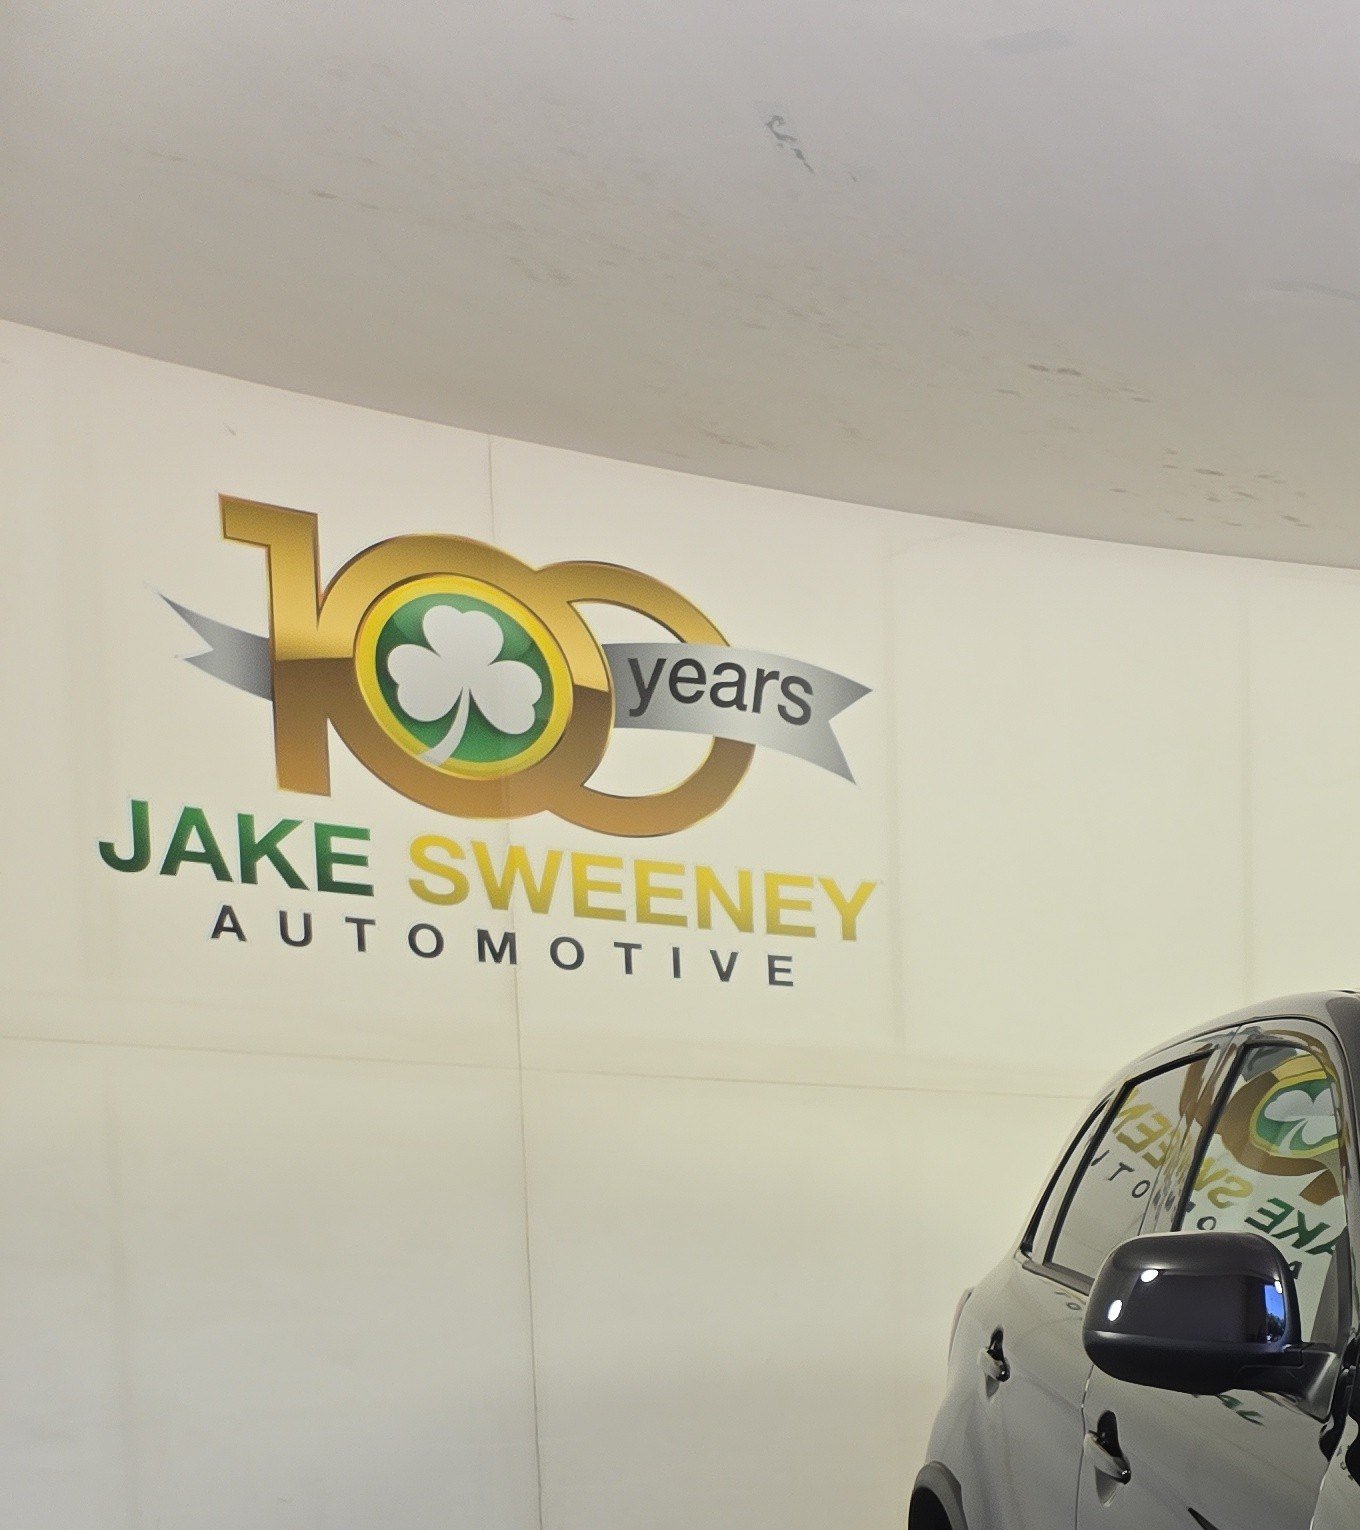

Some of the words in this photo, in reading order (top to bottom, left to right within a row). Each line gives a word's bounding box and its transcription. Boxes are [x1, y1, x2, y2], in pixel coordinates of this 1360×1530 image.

[219, 494, 755, 837] 100
[627, 648, 815, 727] years
[98, 799, 374, 897] JAKE
[408, 834, 879, 941] SWEENEY
[210, 904, 795, 987] AUTOMOTIVE
